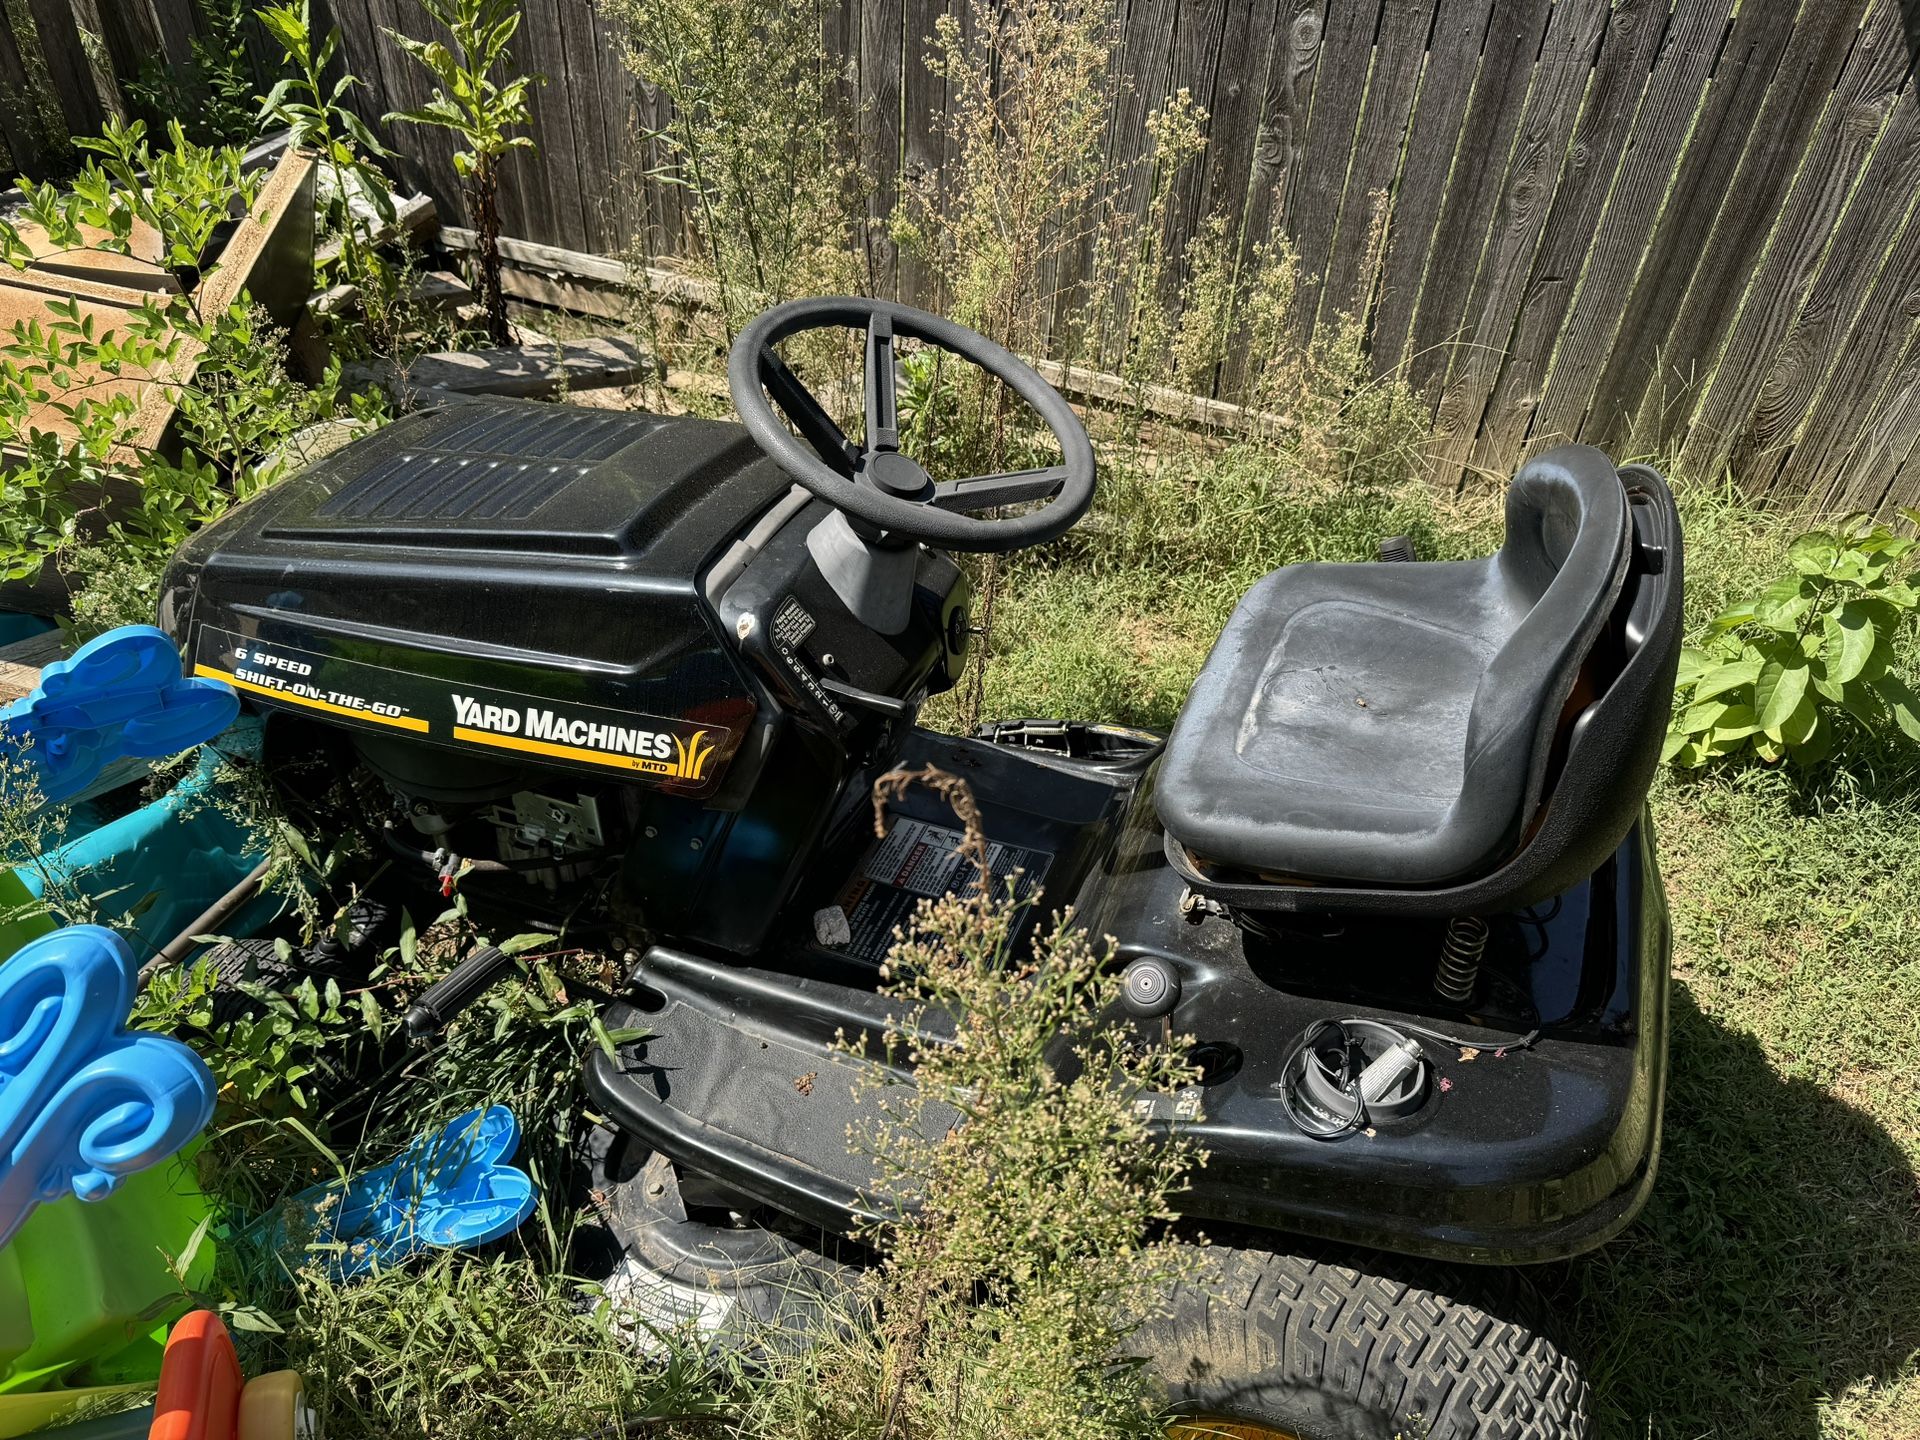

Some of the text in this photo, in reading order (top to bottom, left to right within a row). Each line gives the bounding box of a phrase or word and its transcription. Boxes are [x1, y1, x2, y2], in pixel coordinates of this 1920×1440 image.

[232, 647, 312, 676] 6 SPEED
[786, 656, 793, 664] 6
[793, 665, 800, 673] 5
[801, 673, 807, 681] 4
[808, 682, 815, 690] 3
[815, 690, 822, 699] 2
[632, 760, 668, 772] by MTD
[901, 844, 926, 877] DANGER
